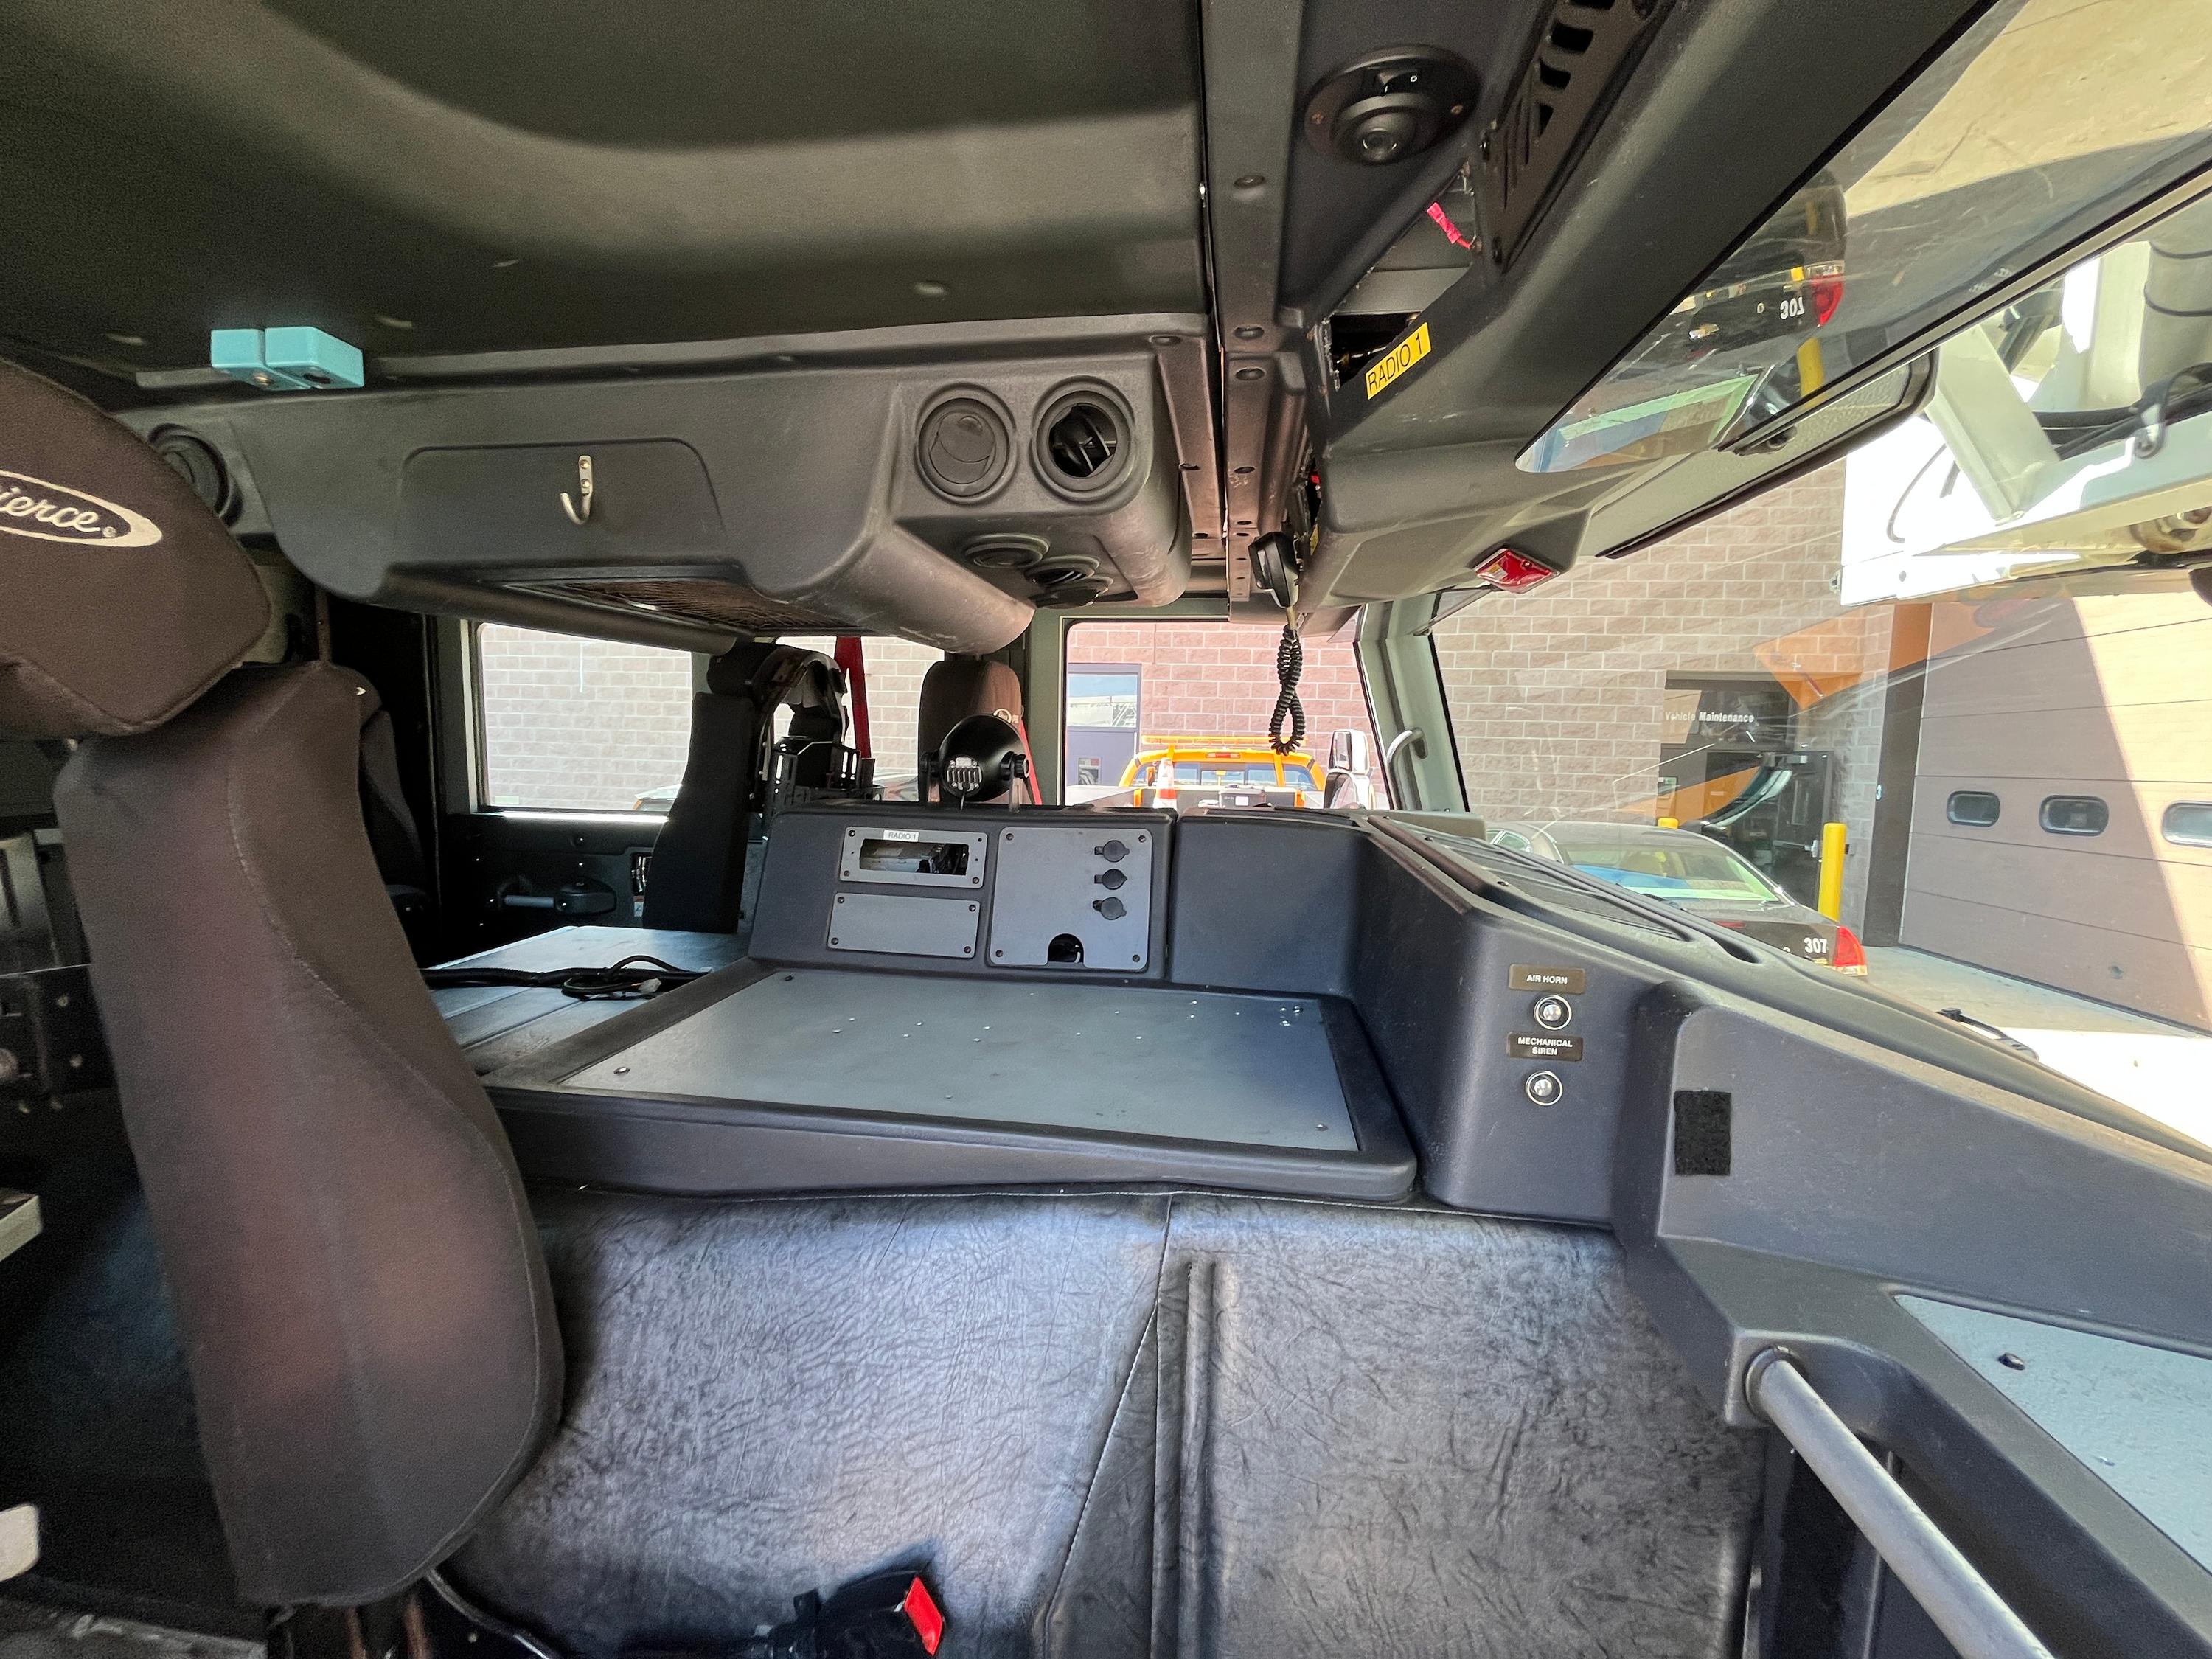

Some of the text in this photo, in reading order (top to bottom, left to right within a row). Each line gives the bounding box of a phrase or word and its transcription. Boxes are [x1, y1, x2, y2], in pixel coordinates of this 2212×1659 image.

[1368, 333, 1422, 394] RADIO 1
[0, 486, 101, 532] ierce
[1665, 711, 1755, 723] Vehicle Maintenance
[888, 832, 911, 840] RADIO
[1804, 937, 1828, 954] 307
[1526, 974, 1568, 984] AIR HORN
[1517, 1037, 1573, 1048] MECHANICAL
[1531, 1046, 1558, 1056] SIREN
